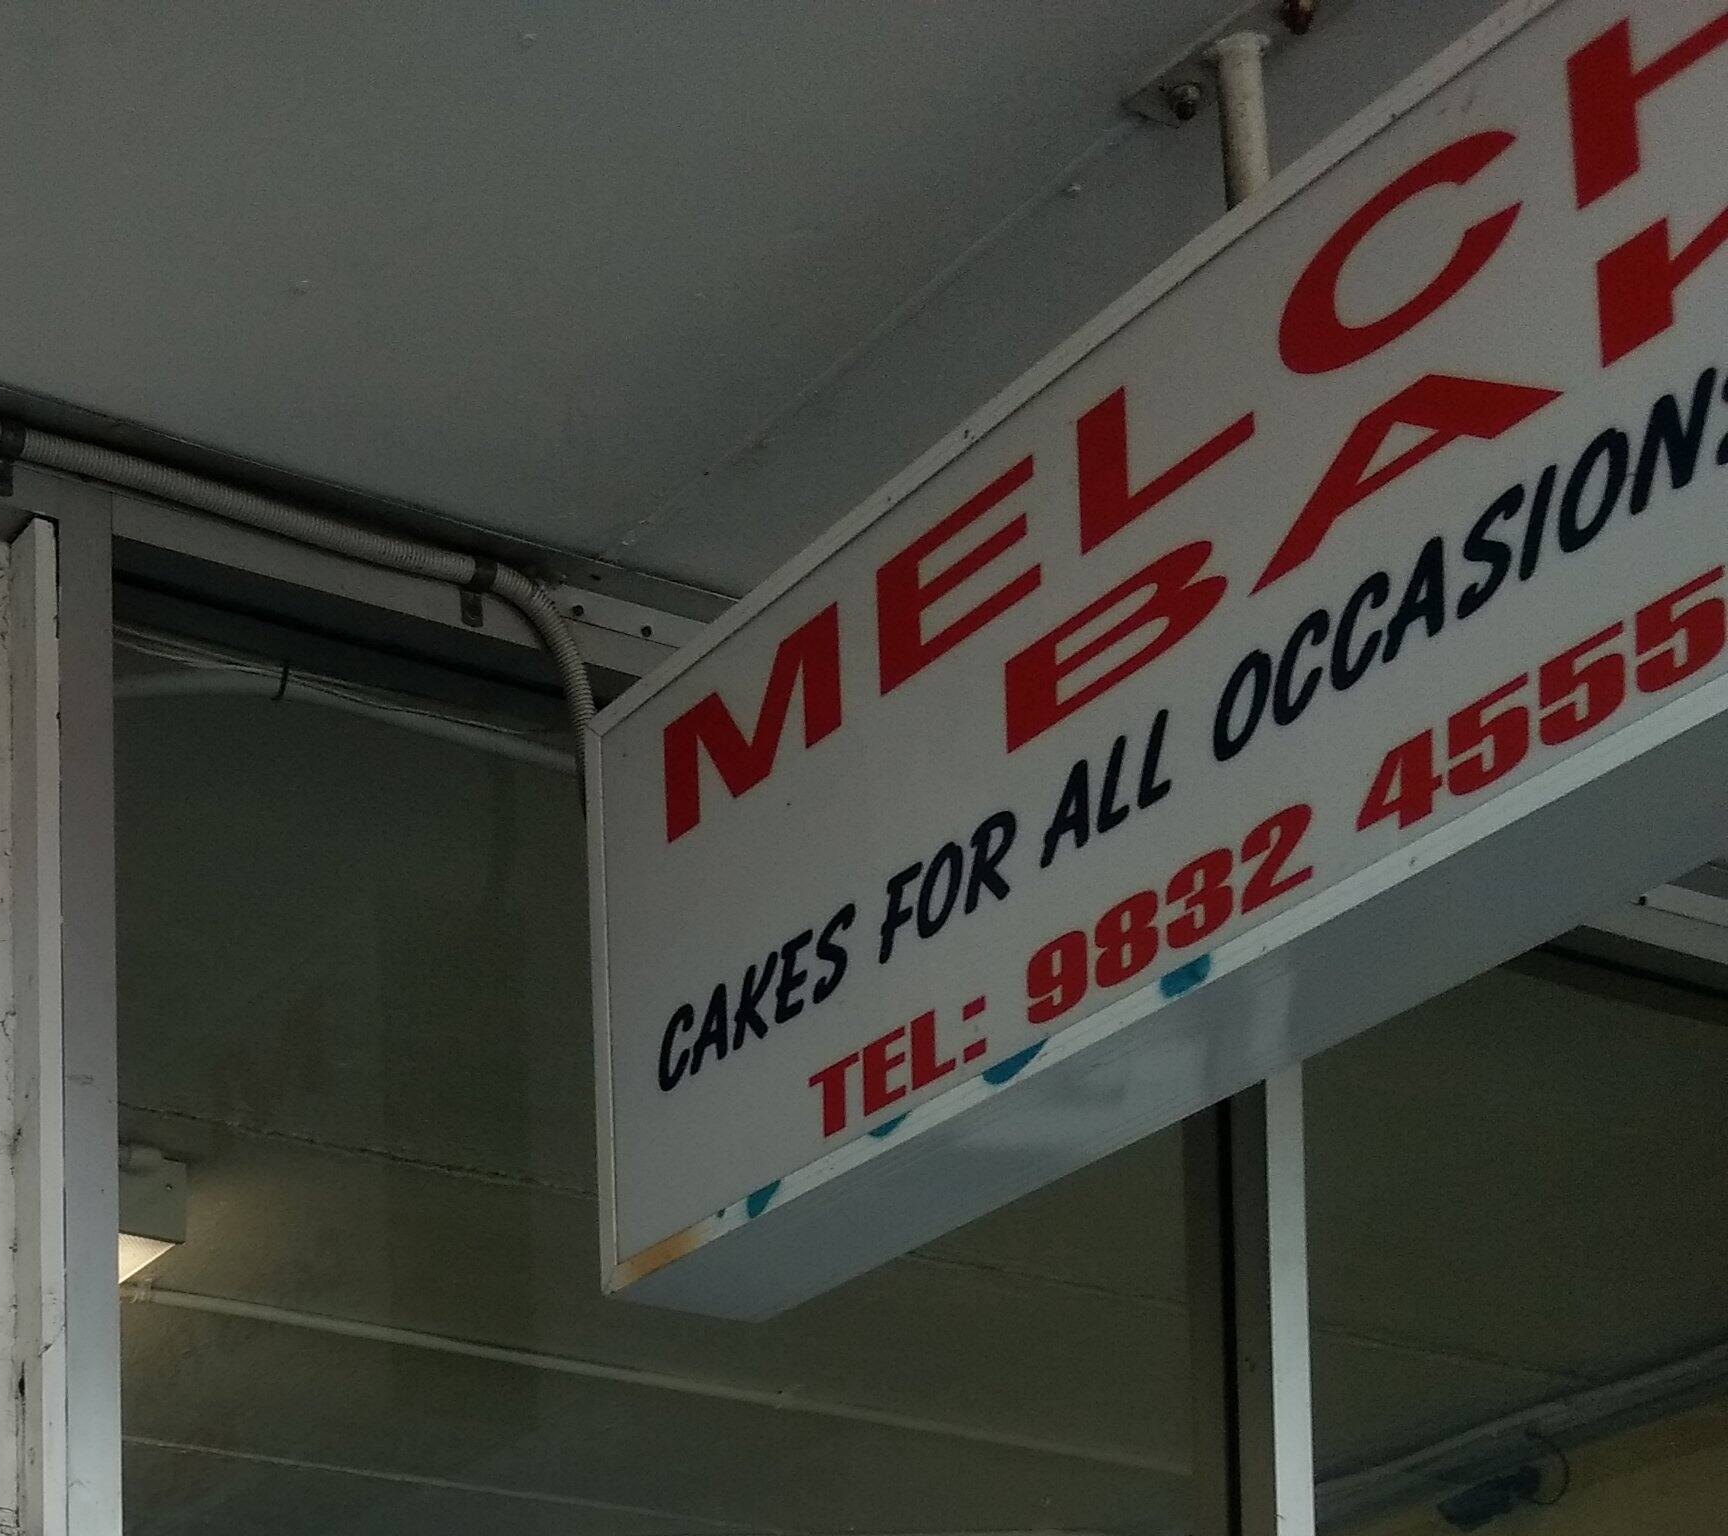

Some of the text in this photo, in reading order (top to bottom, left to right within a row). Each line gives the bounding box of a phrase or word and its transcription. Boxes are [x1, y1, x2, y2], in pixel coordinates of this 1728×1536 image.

[658, 366, 1728, 1092] CAKES FOR ALL OCCASION
[808, 564, 1727, 1138] TEL: 9832 4555
